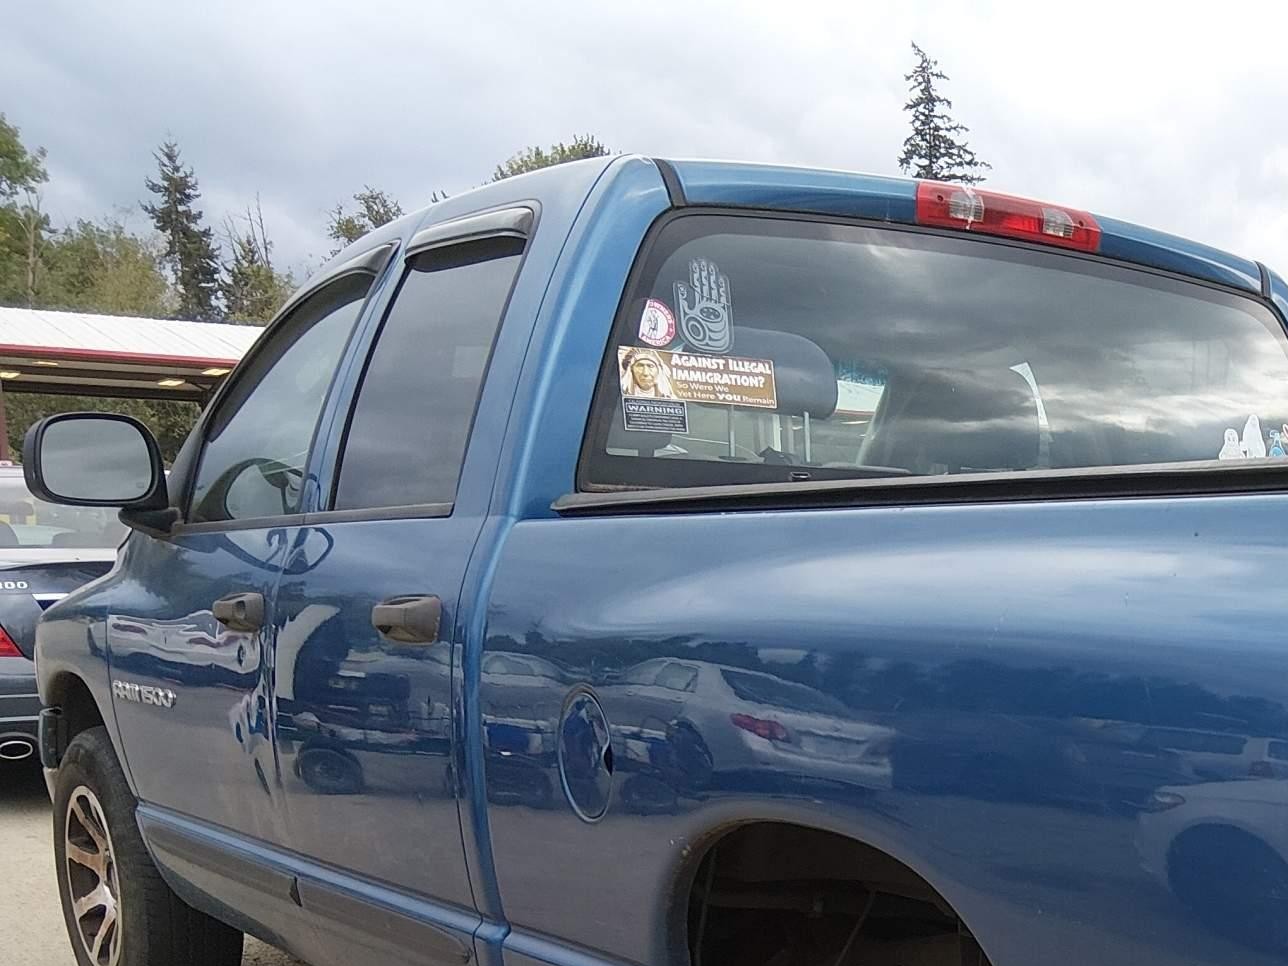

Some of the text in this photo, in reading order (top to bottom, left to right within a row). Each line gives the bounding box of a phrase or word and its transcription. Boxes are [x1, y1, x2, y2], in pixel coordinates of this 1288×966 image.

[671, 353, 772, 374] AGAINST ILLEGAL
[672, 367, 765, 388] IMMIGRATION?
[677, 381, 730, 393] So Were We
[677, 390, 692, 398] Yet
[693, 391, 716, 400] Here
[742, 396, 775, 405] Remain
[627, 404, 683, 415] WARNING
